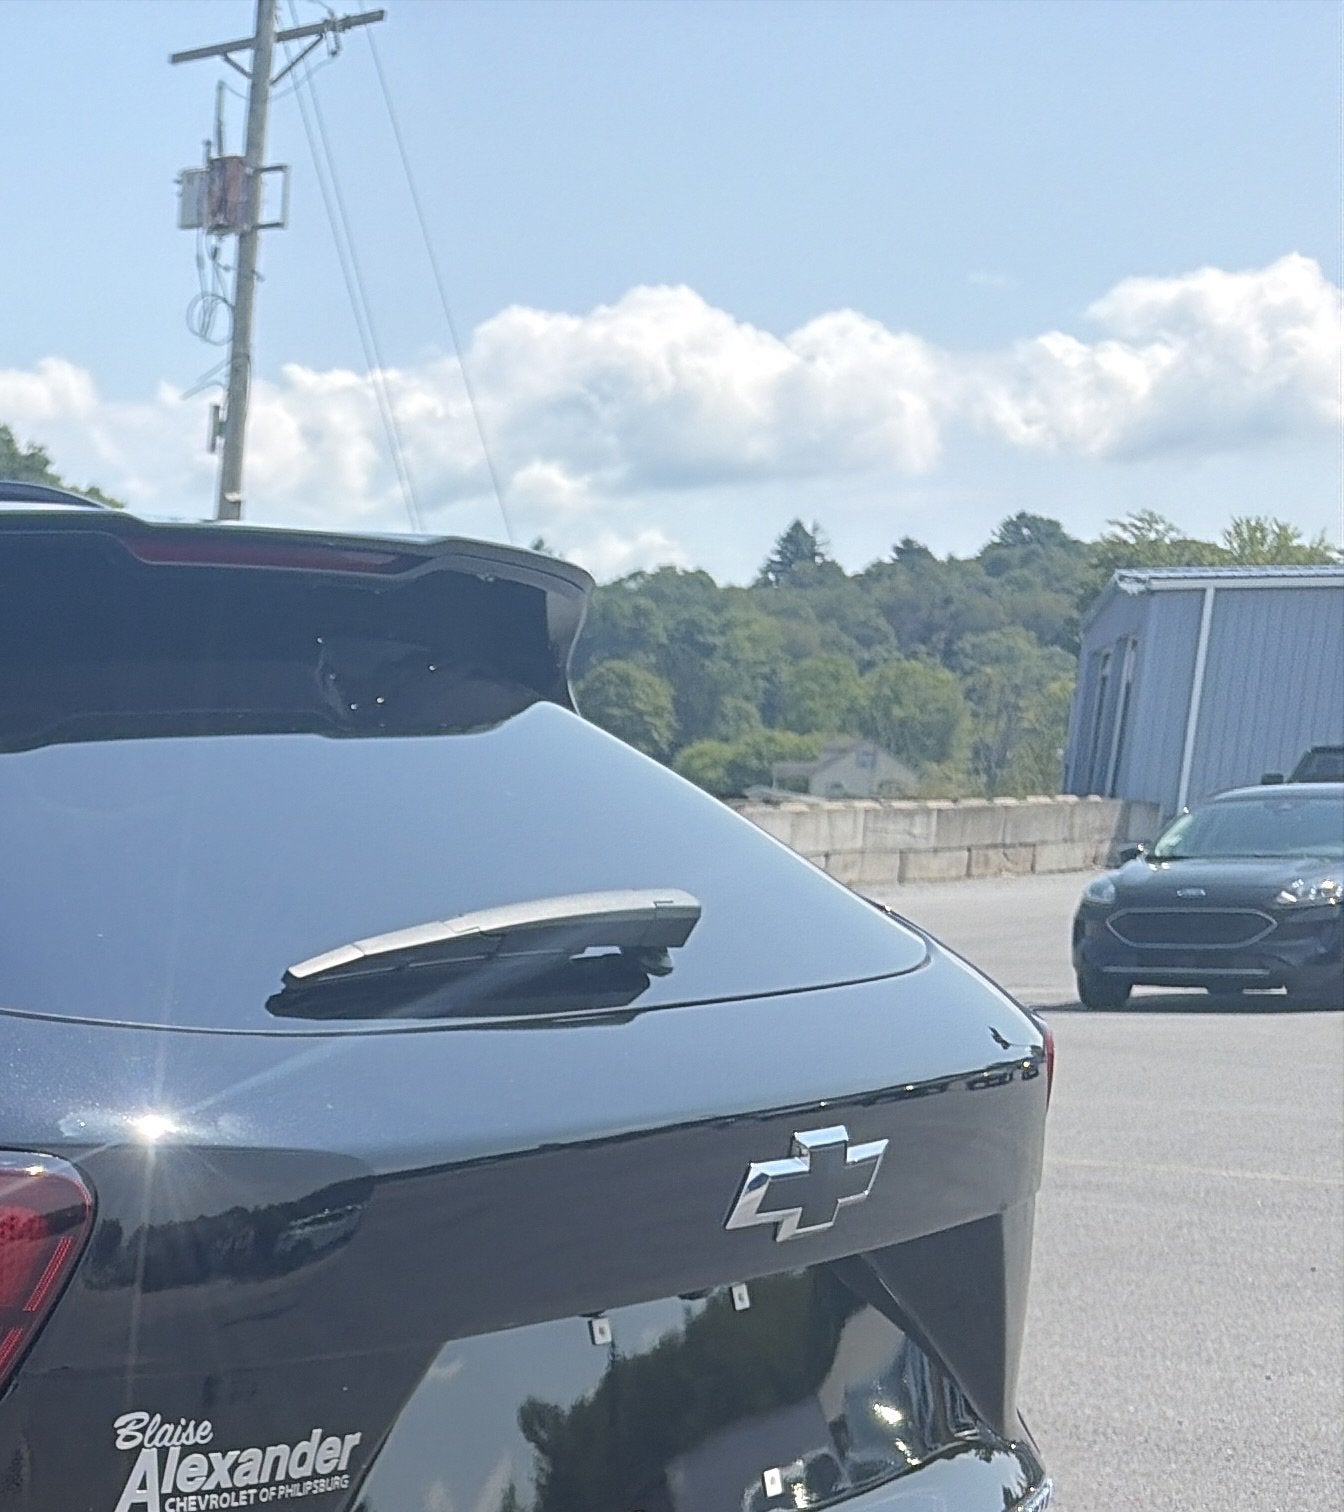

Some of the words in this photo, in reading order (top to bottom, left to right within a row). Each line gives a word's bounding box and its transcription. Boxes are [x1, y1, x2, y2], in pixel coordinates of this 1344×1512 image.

[113, 1411, 214, 1450] Blaise
[259, 1486, 277, 1503] OF
[277, 1474, 351, 1500] PHILIPSBURG
